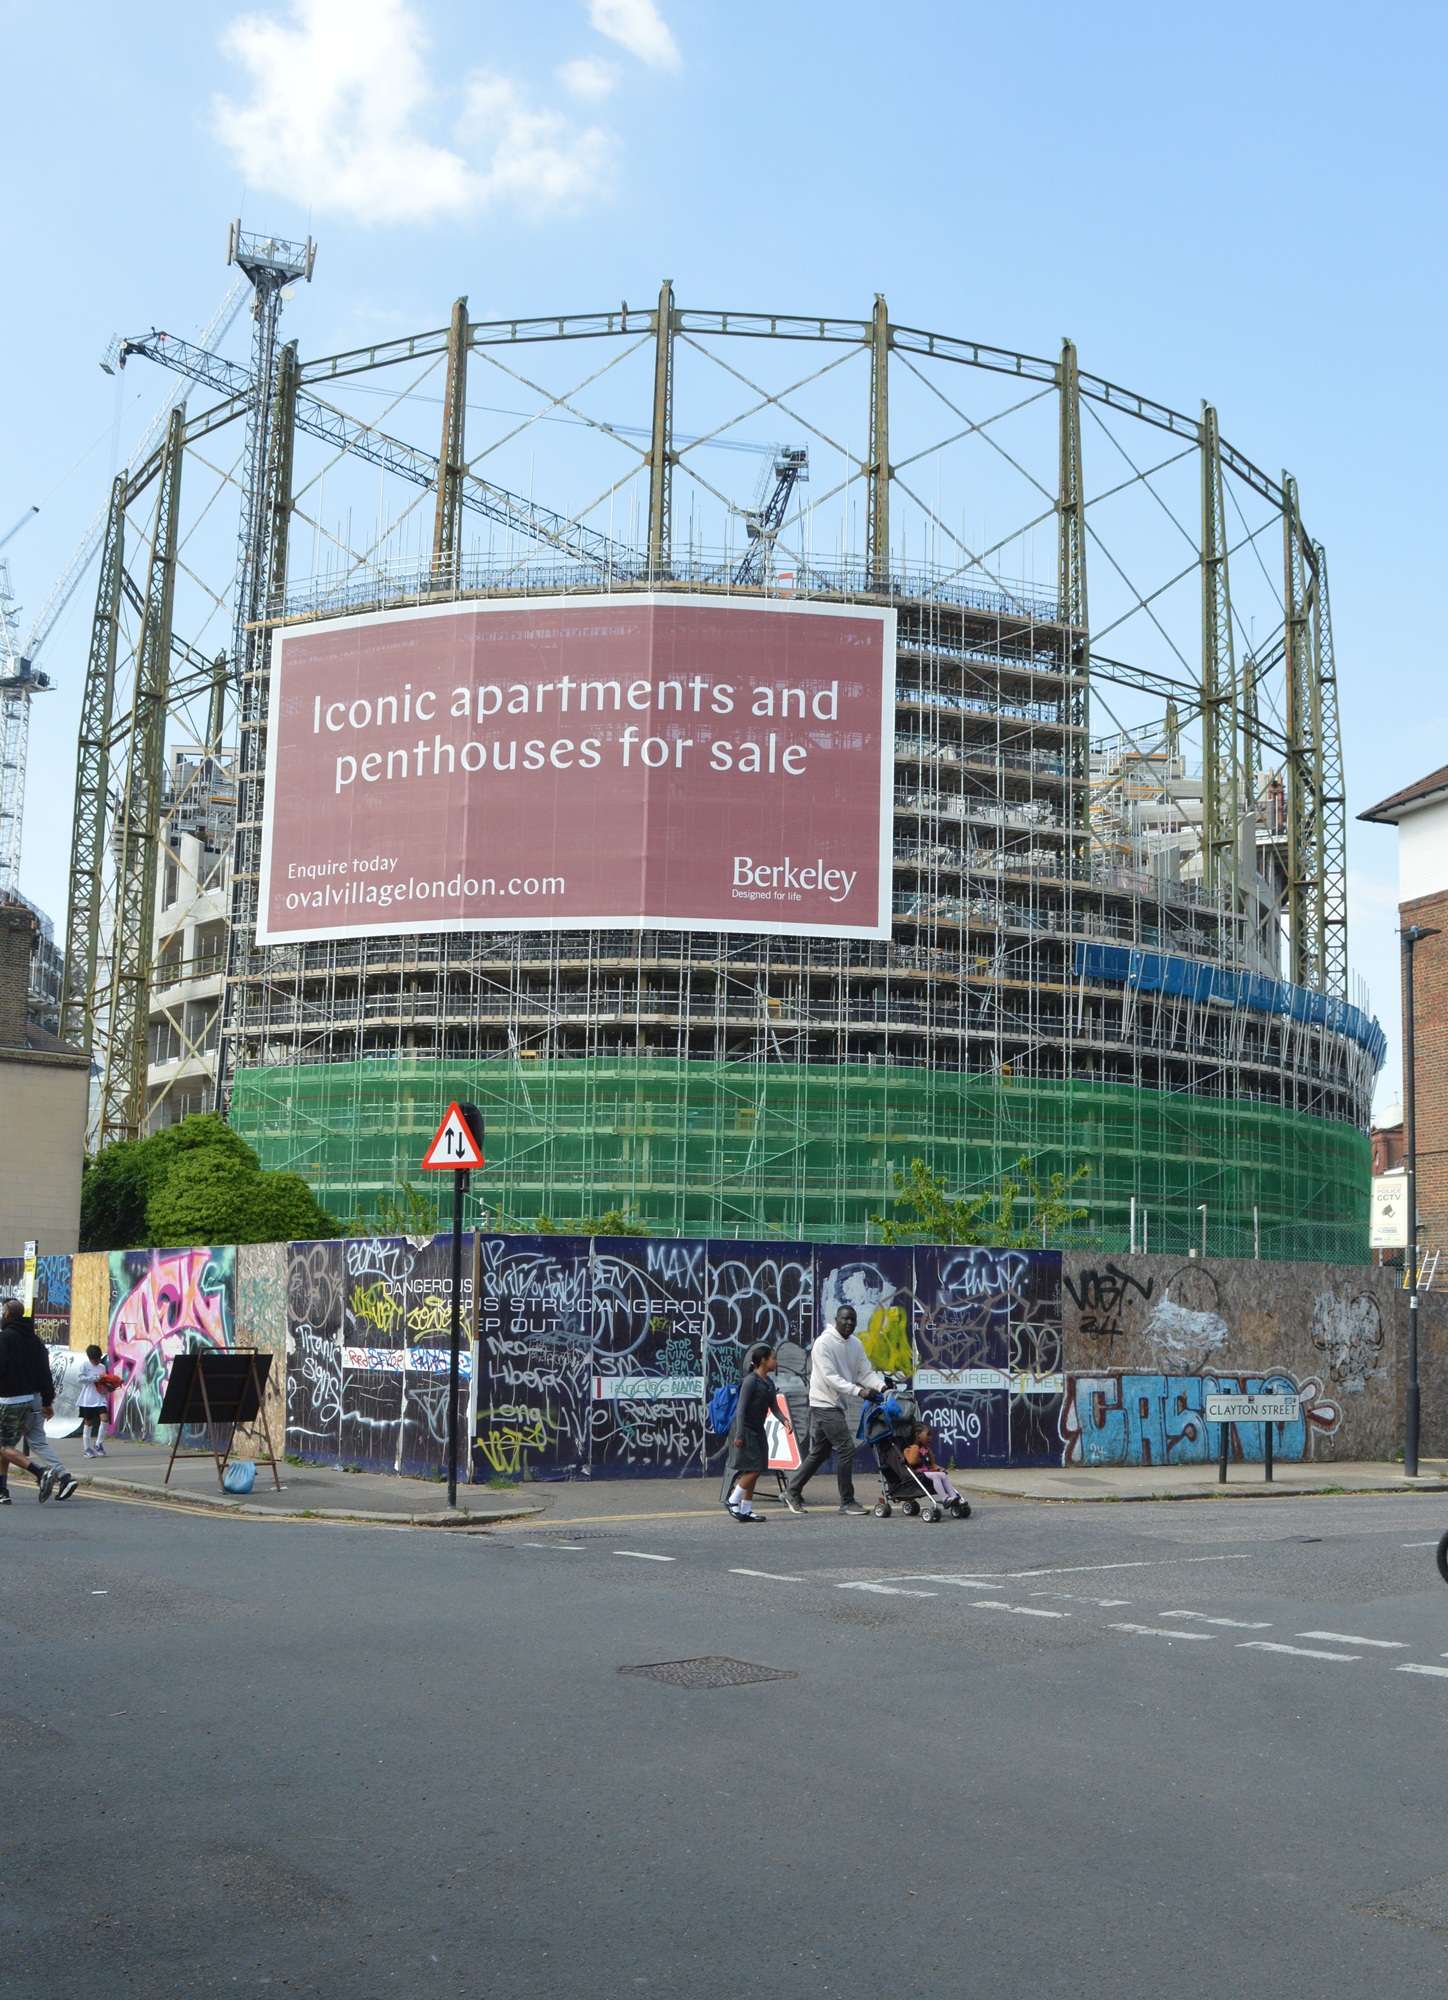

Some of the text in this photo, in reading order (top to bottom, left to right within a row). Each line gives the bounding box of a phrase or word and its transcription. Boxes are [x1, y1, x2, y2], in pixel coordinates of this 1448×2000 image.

[312, 675, 840, 734] Iconic apartments and
[334, 726, 808, 793] penthouses for sale
[287, 854, 399, 880] Enquire today
[732, 856, 858, 902] Berkeley
[285, 873, 566, 911] ovalvillagelondon.com
[731, 888, 802, 901] Designed for life
[1377, 1194, 1401, 1202] CCTV
[511, 1318, 562, 1333] OUT
[666, 1338, 692, 1351] STOP
[918, 1373, 1001, 1385] REQUIRED
[1209, 1404, 1297, 1416] CLAYTON STREET
